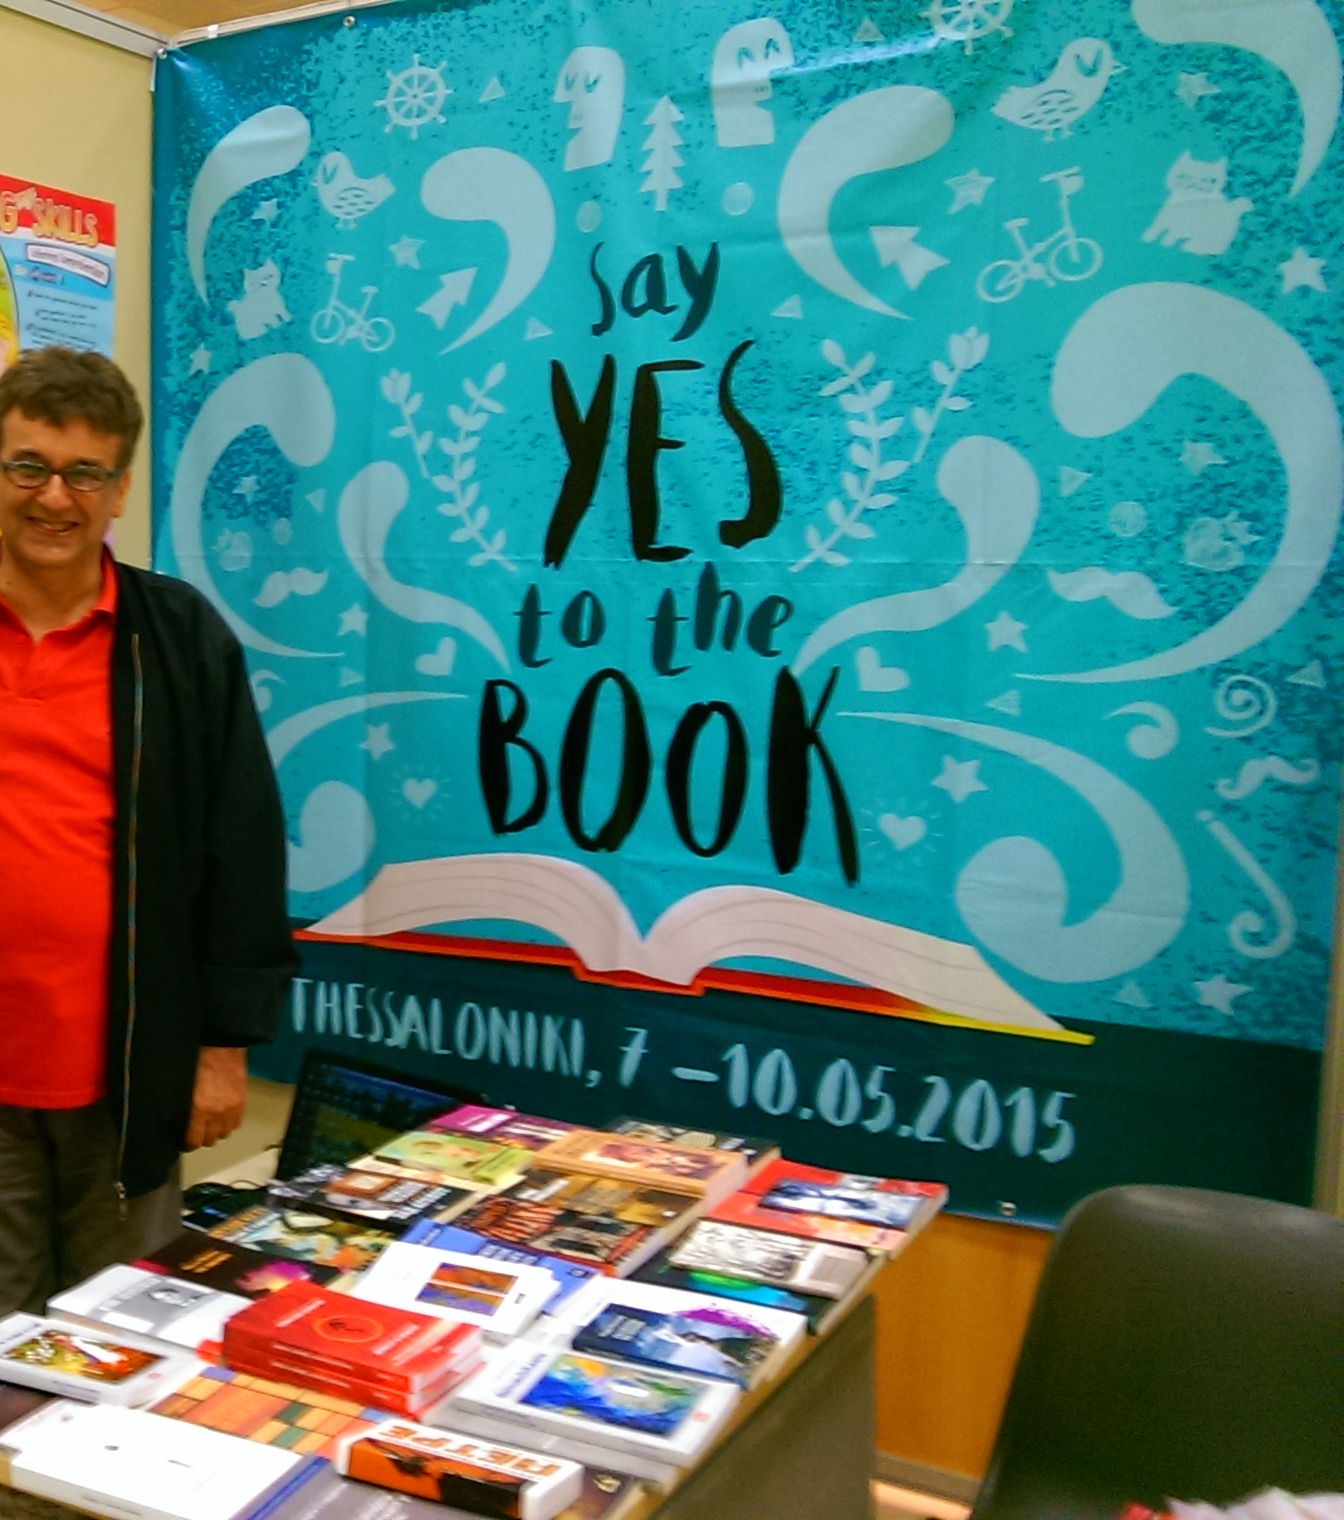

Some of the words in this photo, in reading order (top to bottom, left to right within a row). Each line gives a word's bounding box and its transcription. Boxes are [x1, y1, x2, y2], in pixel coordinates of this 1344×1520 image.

[33, 197, 99, 247] SKILLS
[544, 339, 784, 570] YES
[513, 584, 605, 668] to
[646, 561, 794, 677] the
[478, 665, 861, 887] BOOK
[291, 977, 603, 1088] THESSALONIKI,
[619, 1027, 649, 1089] 7
